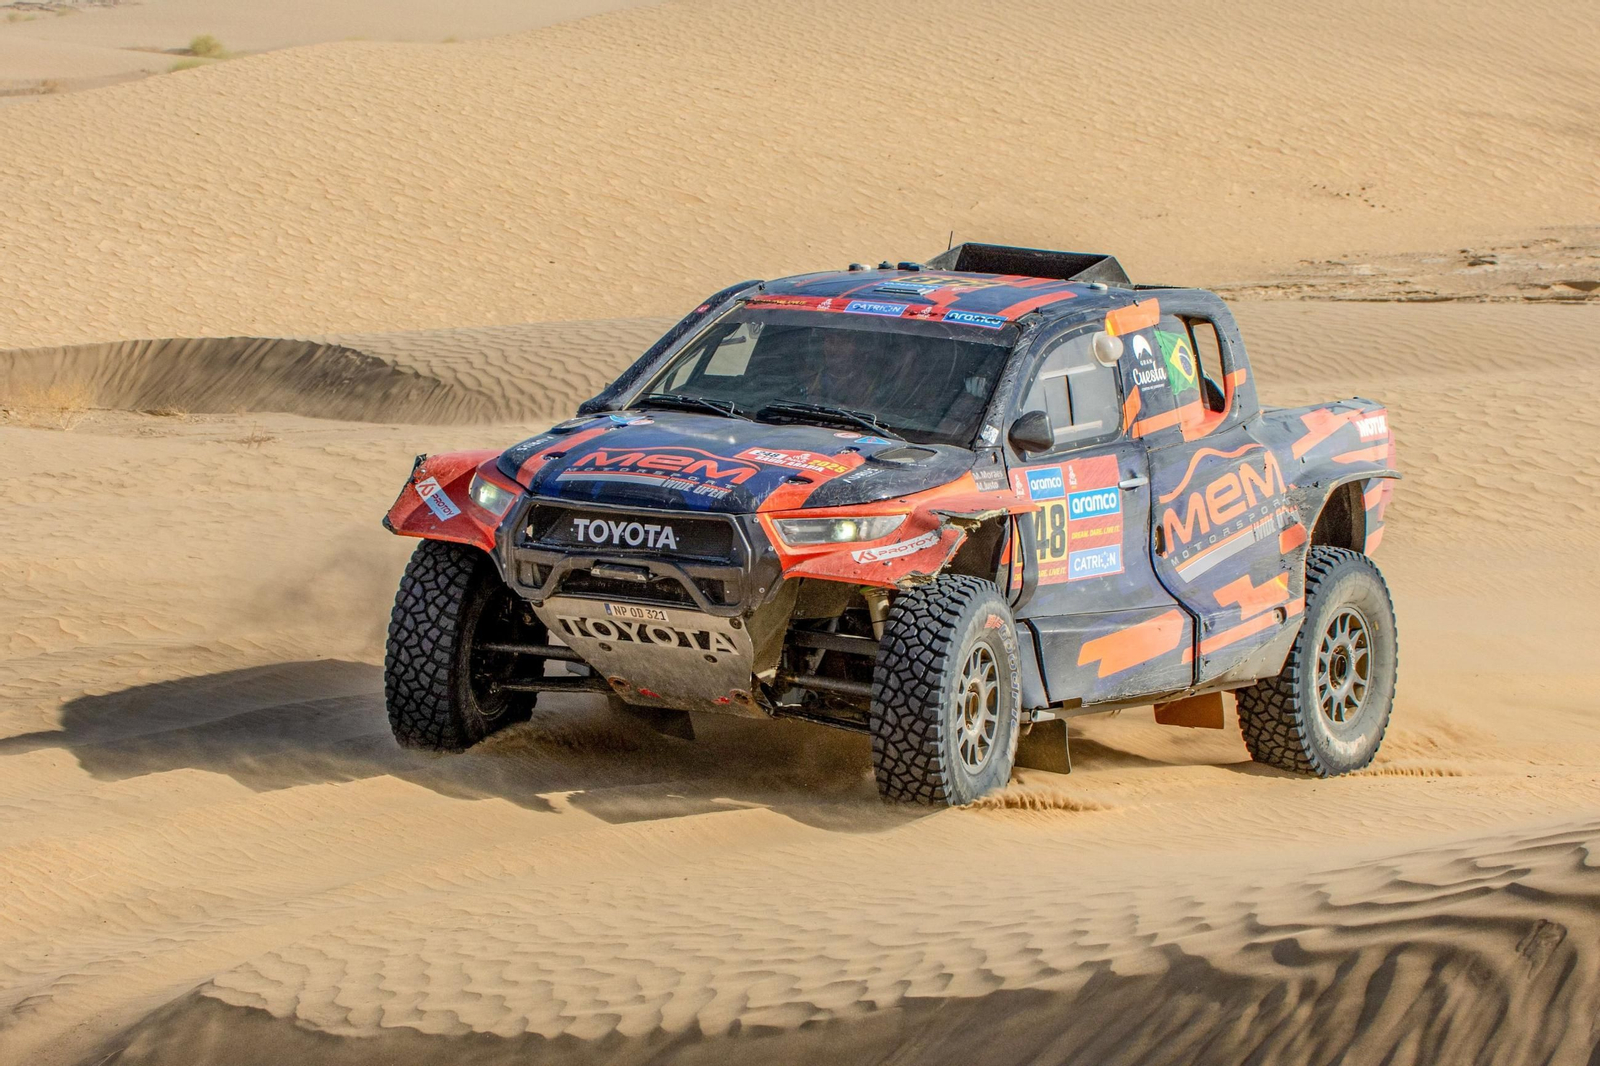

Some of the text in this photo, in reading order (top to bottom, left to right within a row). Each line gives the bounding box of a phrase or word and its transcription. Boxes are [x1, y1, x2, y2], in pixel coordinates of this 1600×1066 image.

[852, 303, 901, 314] CATRION
[1132, 360, 1167, 386] Cuesta
[755, 456, 824, 472] SAUDI ARABIA
[807, 459, 848, 473] 2025
[565, 467, 738, 489] MOTORSPORT
[1030, 476, 1062, 491] aramco
[692, 485, 731, 500] OPEN
[430, 493, 455, 517] PROTOY
[1072, 492, 1117, 515] aramco
[573, 518, 677, 550] TOYOTA
[878, 535, 934, 557] PROTOY
[1074, 551, 1117, 571] CATRION
[613, 604, 667, 621] NP OD 321
[556, 614, 739, 656] TOYOTA
